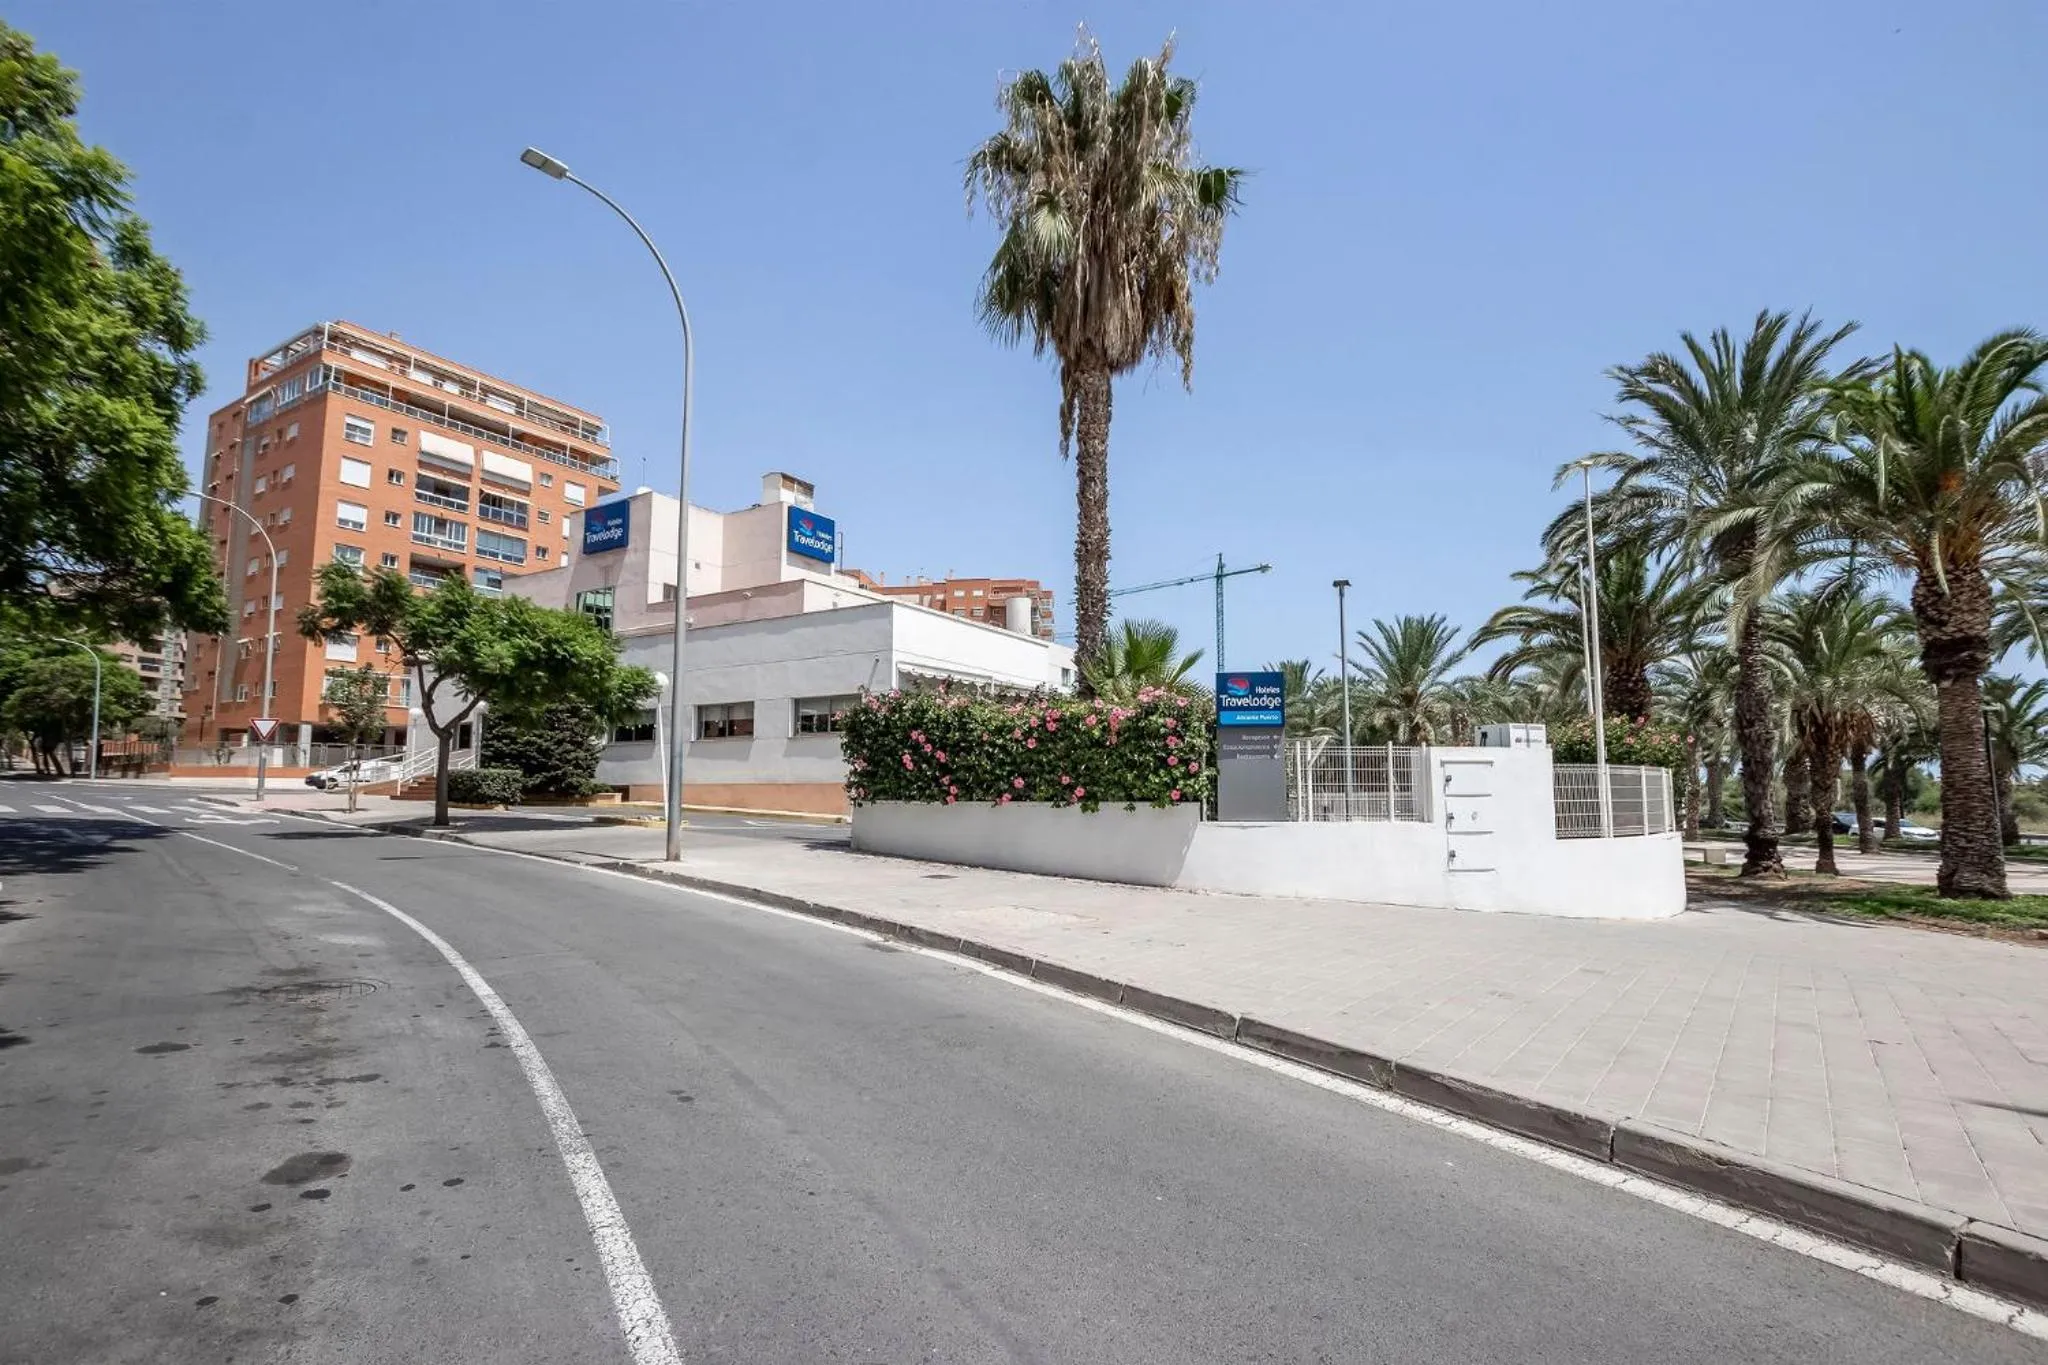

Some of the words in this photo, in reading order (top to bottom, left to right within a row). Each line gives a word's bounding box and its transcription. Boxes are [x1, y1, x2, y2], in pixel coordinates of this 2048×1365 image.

[586, 527, 624, 544] Travelodge
[793, 530, 834, 554] Travelodge
[1255, 686, 1280, 694] Hoteles
[1219, 694, 1282, 709] Travelodge
